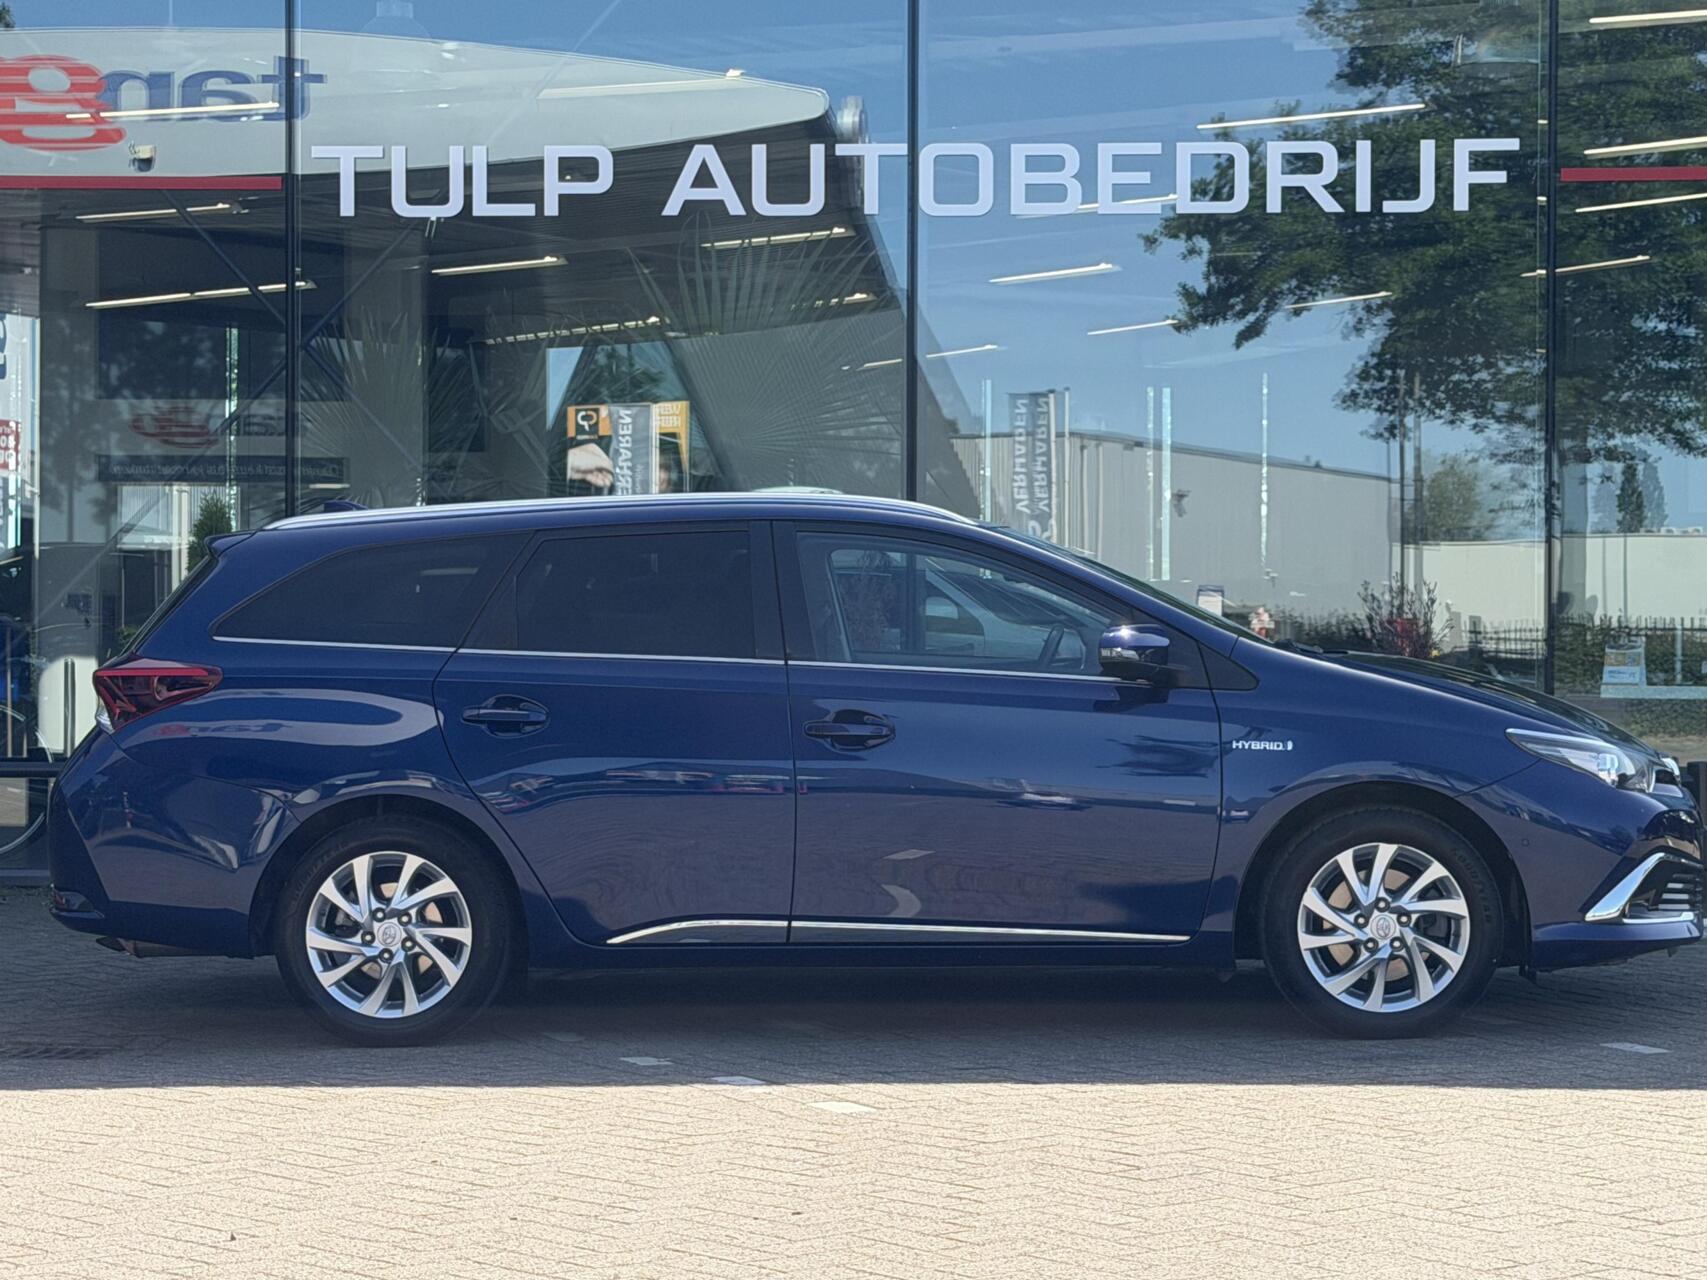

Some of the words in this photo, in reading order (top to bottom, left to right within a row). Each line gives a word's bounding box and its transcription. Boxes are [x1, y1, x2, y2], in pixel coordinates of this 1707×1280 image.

[311, 144, 614, 218] TULP
[661, 138, 1520, 218] AUTOBEDRIJF
[1232, 740, 1285, 751] HYBRID
